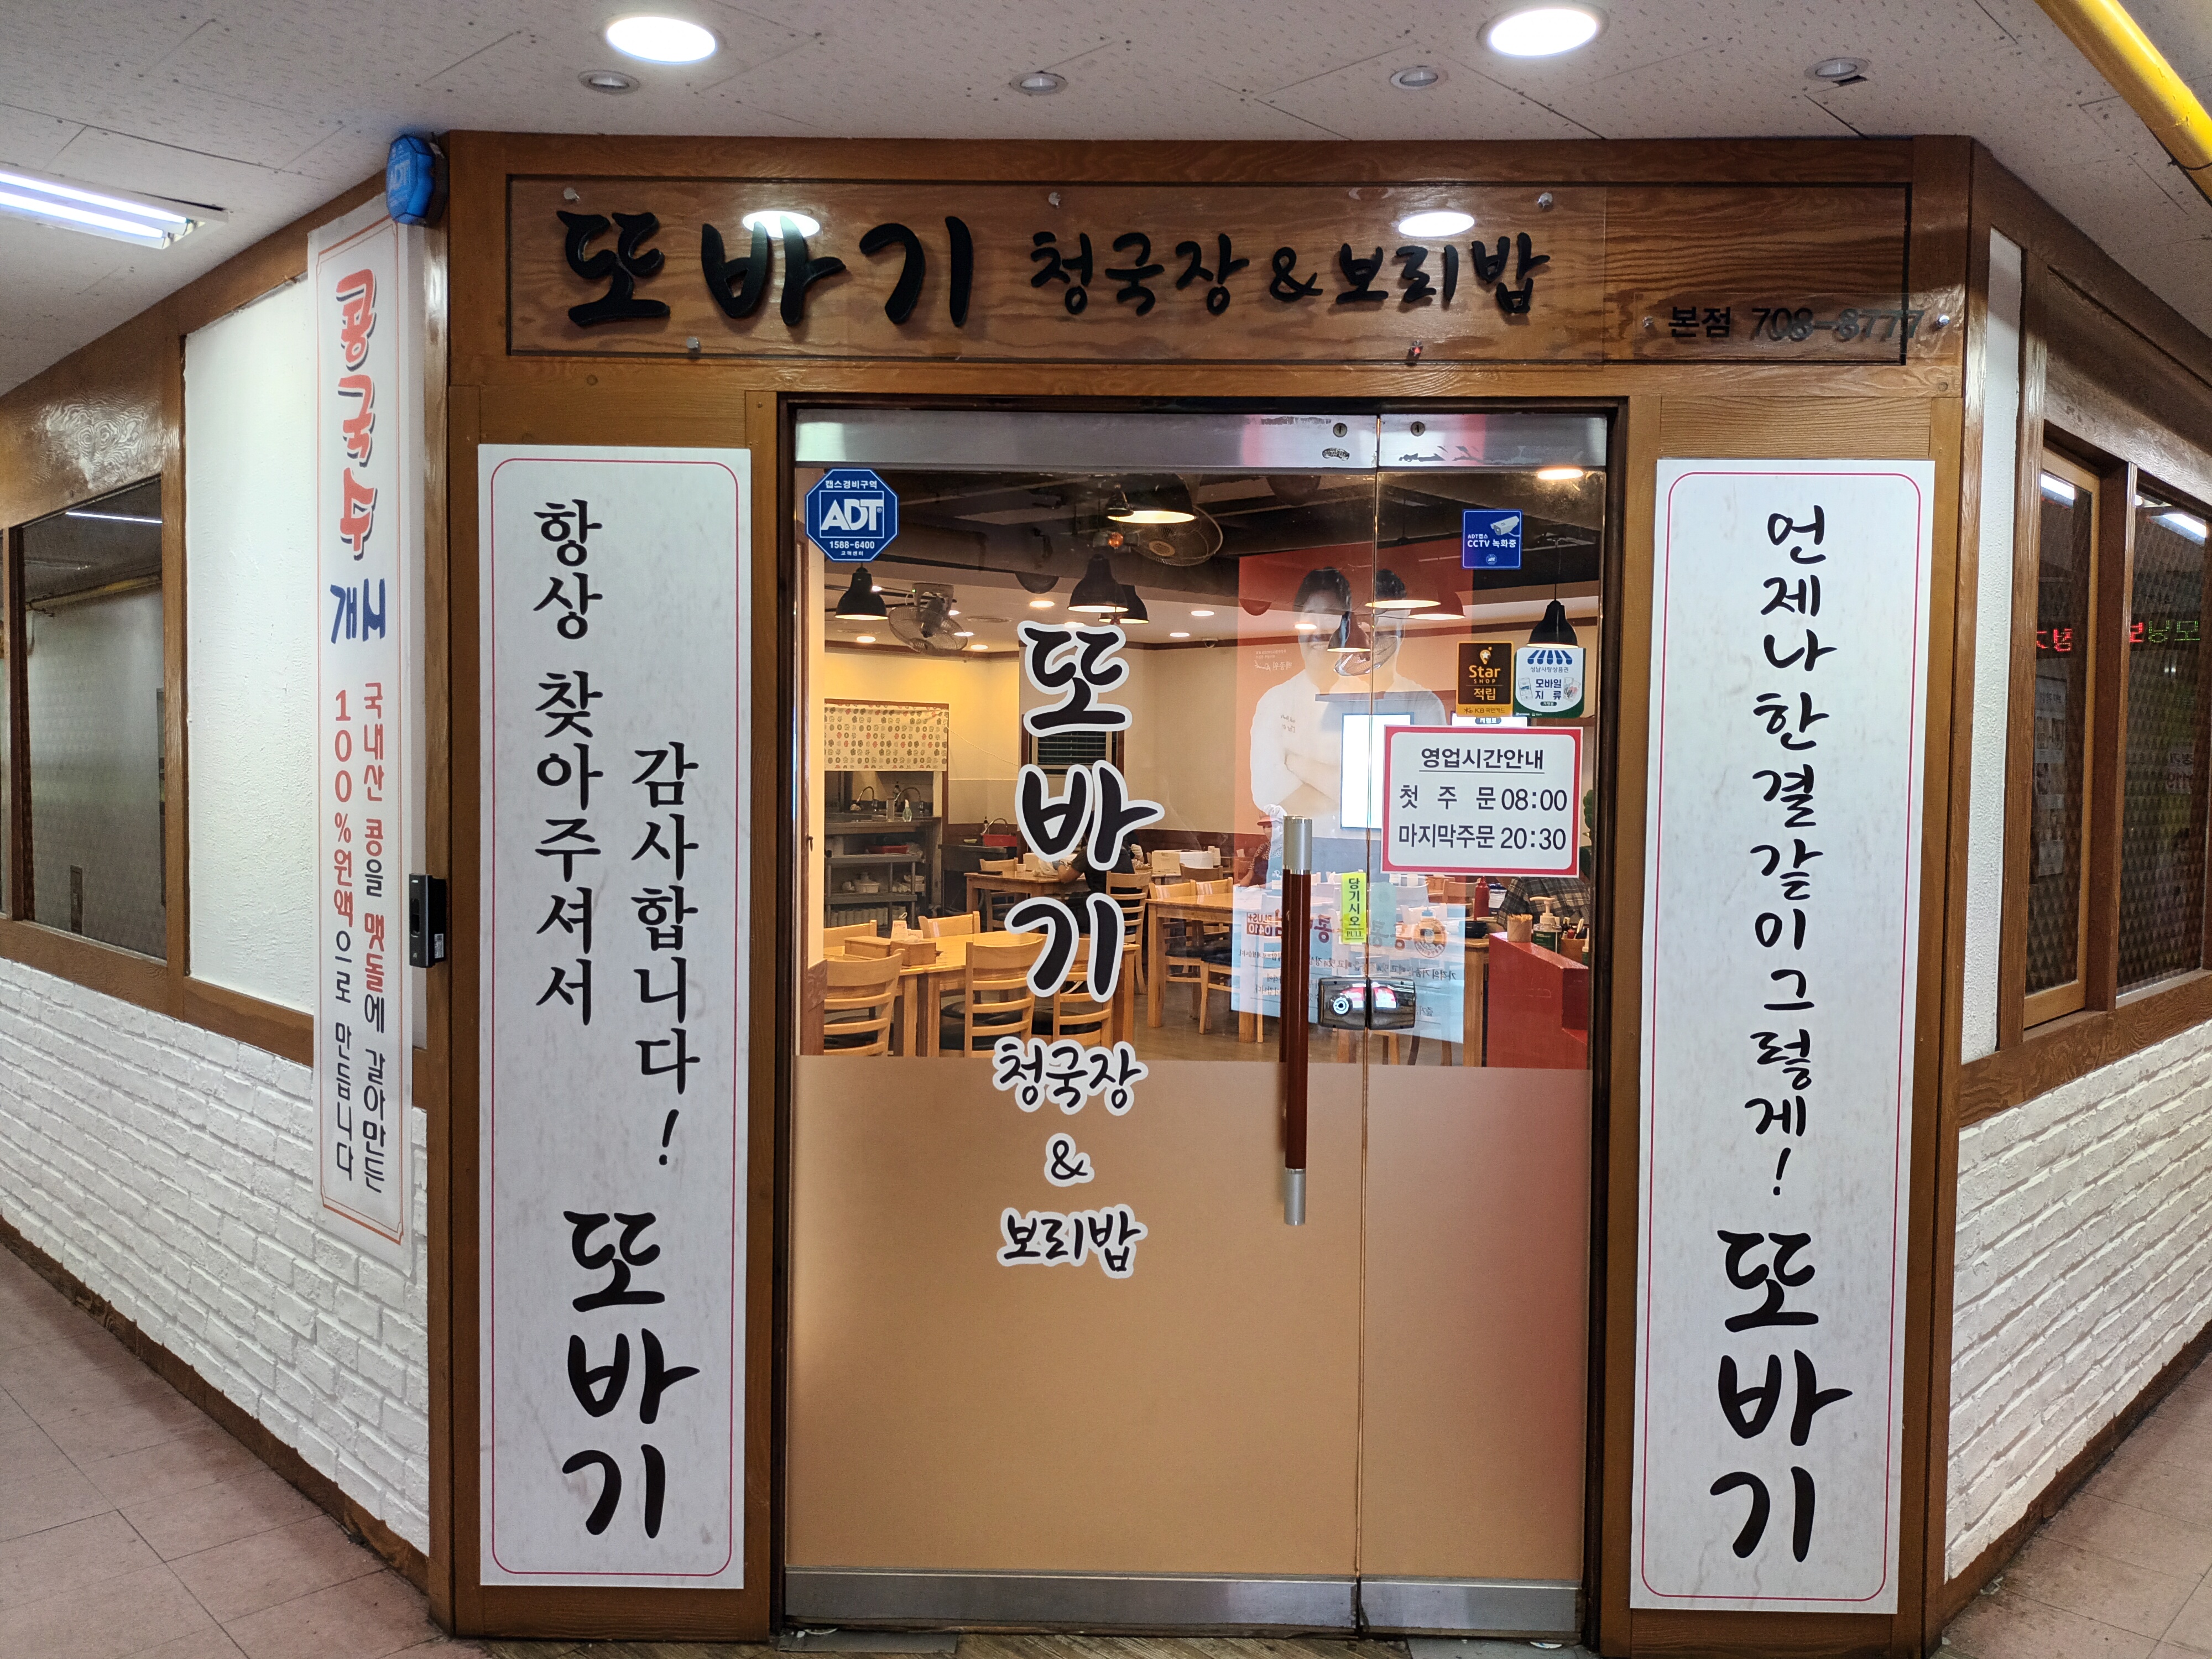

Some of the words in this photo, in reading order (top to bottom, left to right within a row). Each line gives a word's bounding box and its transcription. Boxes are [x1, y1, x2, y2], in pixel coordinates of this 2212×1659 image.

[557, 210, 974, 327] 또바기
[1031, 231, 1250, 315] 청국장
[1269, 246, 1323, 302] &
[1335, 231, 1550, 314] 보리밥
[1668, 306, 1731, 338] 본점
[1751, 306, 1926, 340] 708-8777
[336, 268, 377, 561] 콩국수
[821, 499, 884, 531] ADT
[826, 480, 878, 489] 캡스경비구역
[533, 499, 603, 640] 항상
[829, 540, 875, 550] 1588-6400
[1492, 539, 1517, 548] 녹화중
[1761, 504, 1838, 672] 언제나
[1469, 665, 1501, 678] Star
[1474, 688, 1496, 701] 적립
[1536, 679, 1562, 689] 모바일
[364, 682, 384, 801] 국내산
[1421, 748, 1544, 770] 영업시간안내
[1010, 625, 1161, 998] 또바기
[1501, 788, 1568, 811] 08:00
[364, 818, 384, 898] 콩을
[535, 670, 603, 1025] 찾아주셔서
[1399, 823, 1495, 848] 마지막주문
[1500, 827, 1567, 851] 20:30
[1348, 878, 1360, 926] 당기시오
[364, 912, 384, 1033] 맷돌에
[631, 742, 700, 1166] 감사합니다!
[335, 1022, 353, 1181] 만듭니다
[999, 1043, 1142, 1109] 청국장
[1051, 1139, 1088, 1181] &
[1003, 1211, 1142, 1272] 보리밥
[562, 1211, 700, 1538] 또바기
[1710, 1229, 1853, 1562] 또바기
